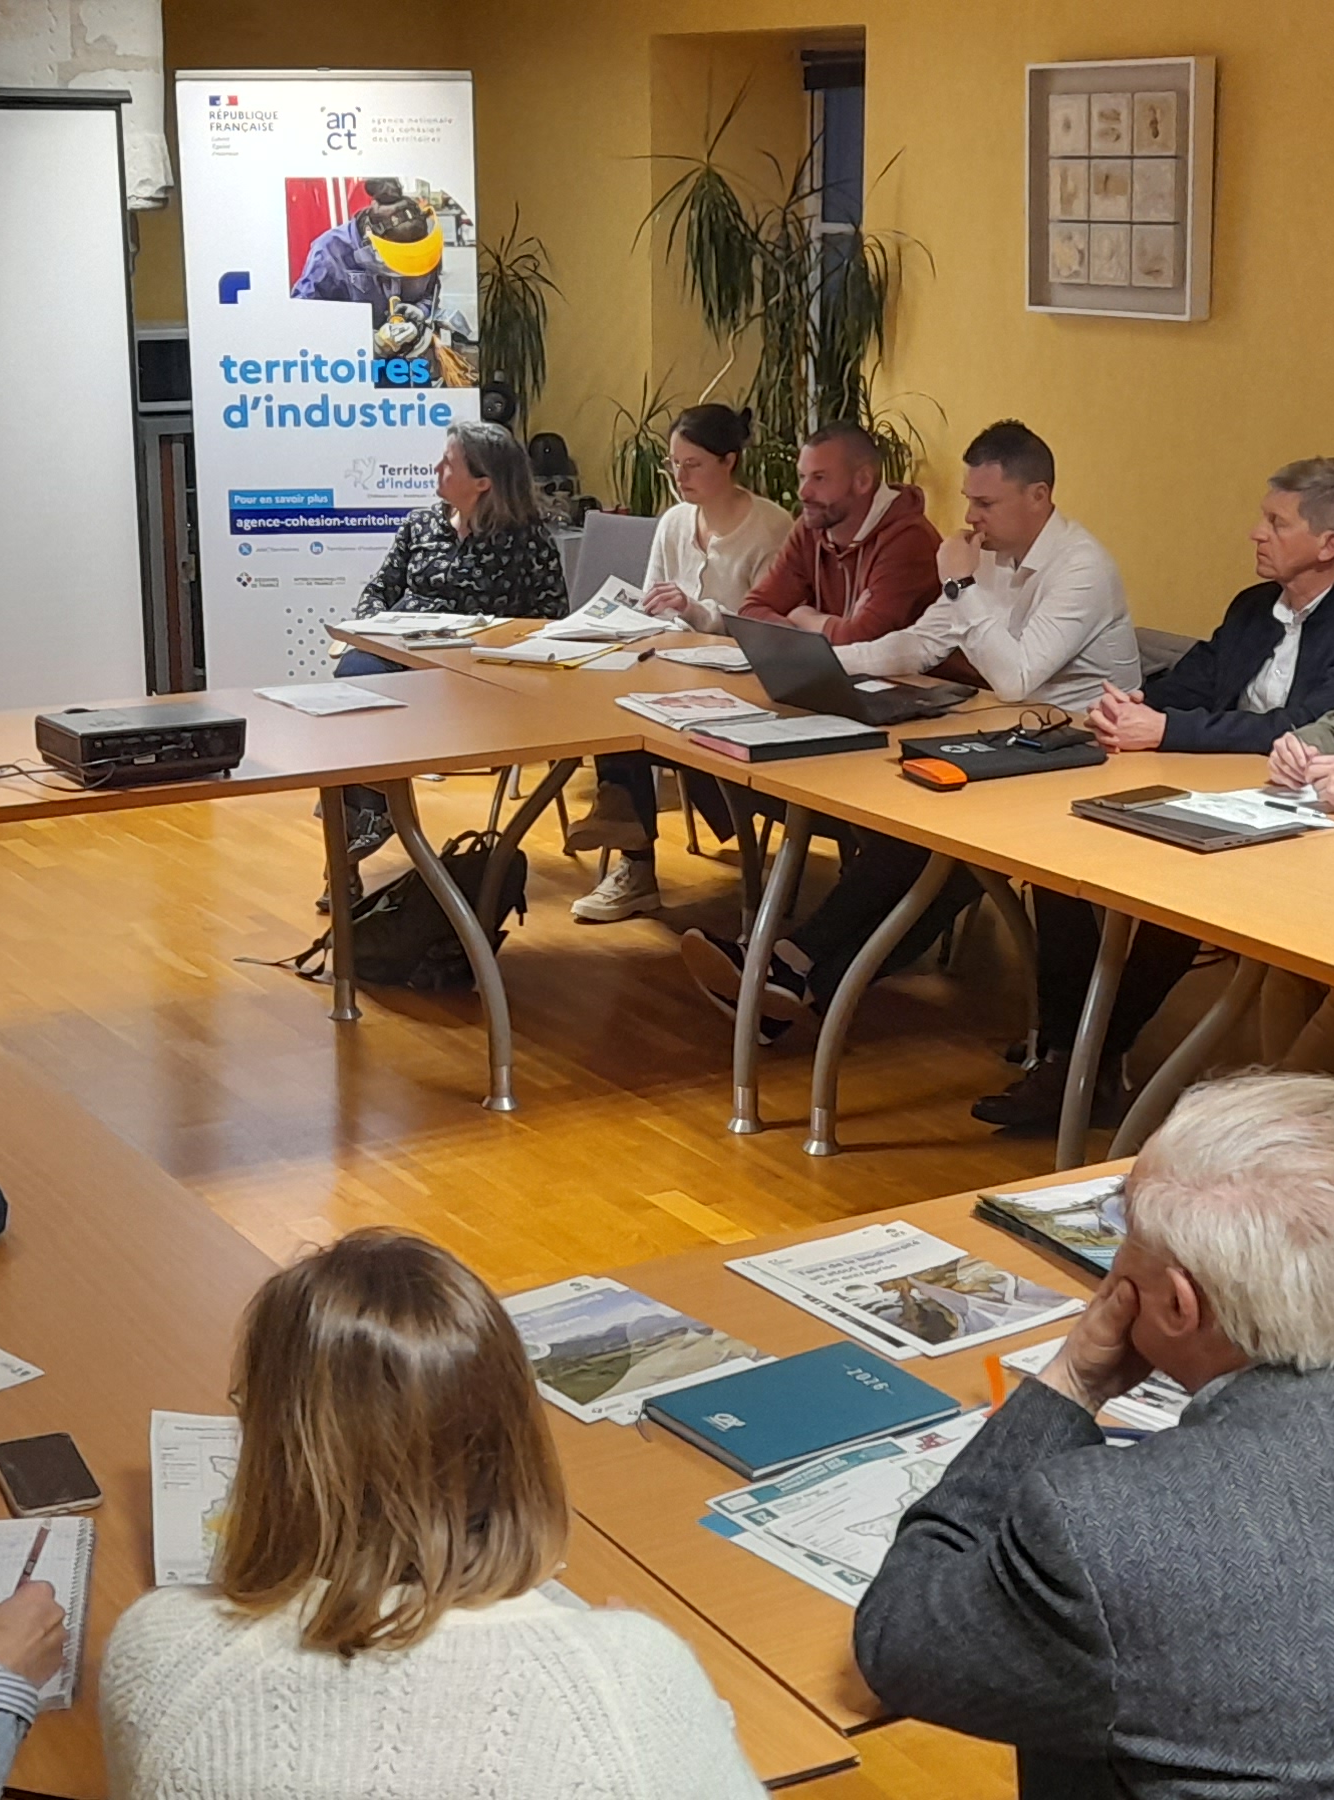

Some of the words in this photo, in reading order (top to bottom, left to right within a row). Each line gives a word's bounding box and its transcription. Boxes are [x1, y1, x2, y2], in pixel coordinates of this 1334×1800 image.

[208, 108, 279, 120] RÉPUBLIQUE
[325, 111, 357, 130] an
[209, 122, 274, 133] FRANÇAISE
[326, 130, 358, 150] ct
[219, 348, 431, 385] territoires
[222, 392, 453, 429] d'industrie
[378, 463, 438, 476] Territoir
[376, 476, 436, 490] d'indust
[234, 494, 258, 505] Pour
[259, 496, 273, 504] en
[274, 493, 305, 504] savoir
[307, 493, 329, 506] plus
